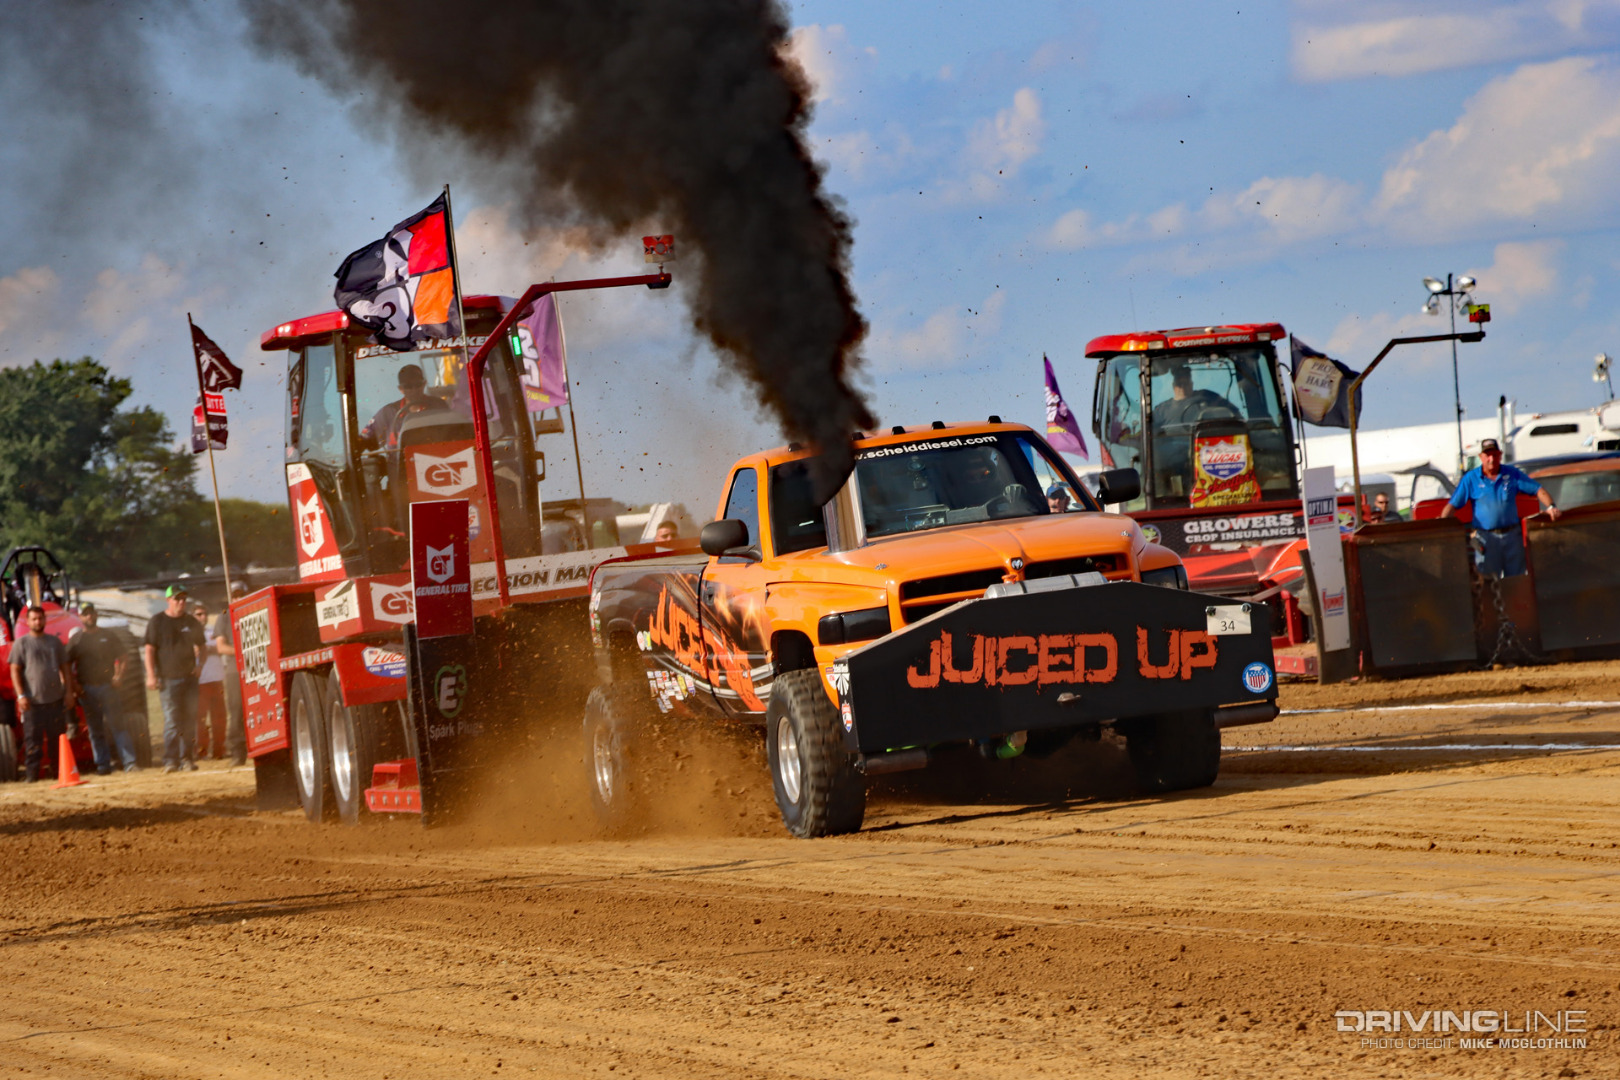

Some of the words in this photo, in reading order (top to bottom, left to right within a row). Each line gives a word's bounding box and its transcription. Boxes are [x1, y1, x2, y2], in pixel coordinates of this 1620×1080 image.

[436, 333, 491, 348] MAKE
[1207, 452, 1243, 464] LUCAS
[424, 461, 468, 487] GT
[1308, 499, 1334, 516] OPTIMA
[1183, 513, 1295, 535] GROWERS
[1185, 533, 1219, 544] CROP
[1220, 527, 1296, 541] INSURANCE
[430, 555, 451, 576] GT
[415, 584, 450, 597] GENERAL
[450, 583, 469, 593] TIRE
[1220, 620, 1236, 632] 34
[906, 627, 1119, 692] JUICED
[1136, 624, 1219, 681] UP
[429, 722, 455, 740] Spark
